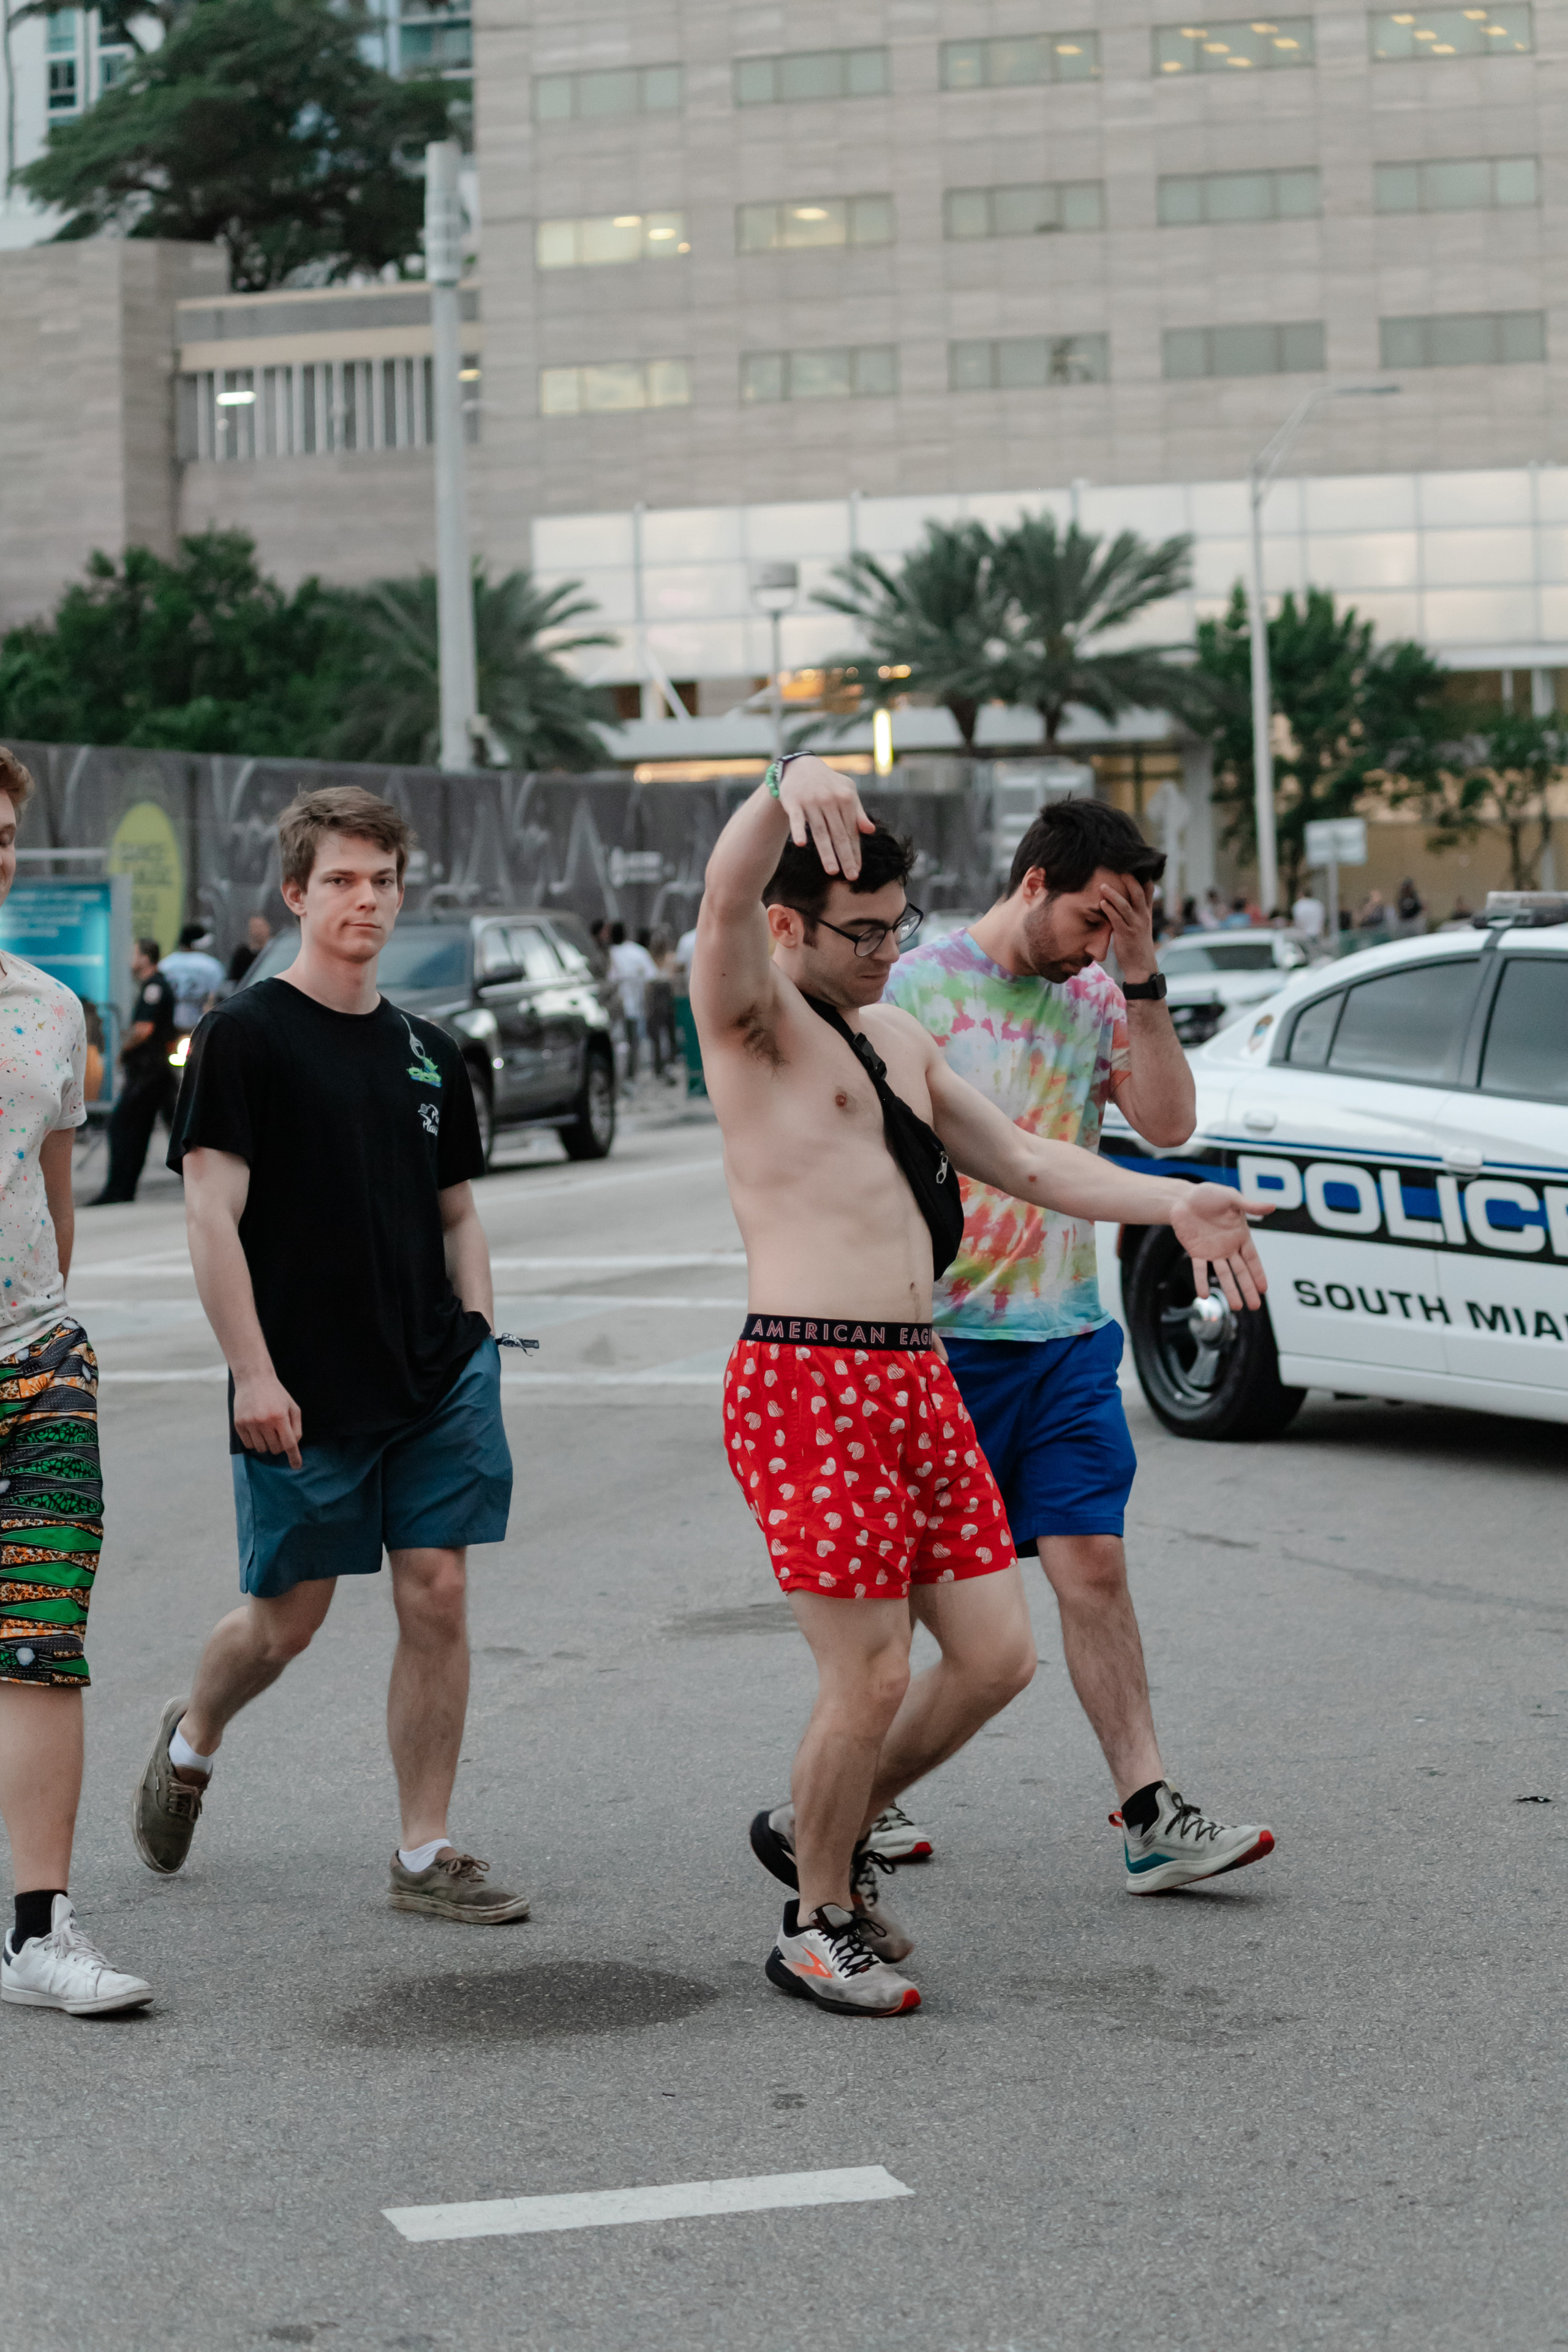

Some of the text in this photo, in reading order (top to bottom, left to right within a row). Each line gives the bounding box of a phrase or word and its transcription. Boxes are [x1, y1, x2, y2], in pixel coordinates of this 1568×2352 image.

[752, 1319, 886, 1344] AMERICAN
[1293, 1279, 1568, 1341] SOUTH MIA
